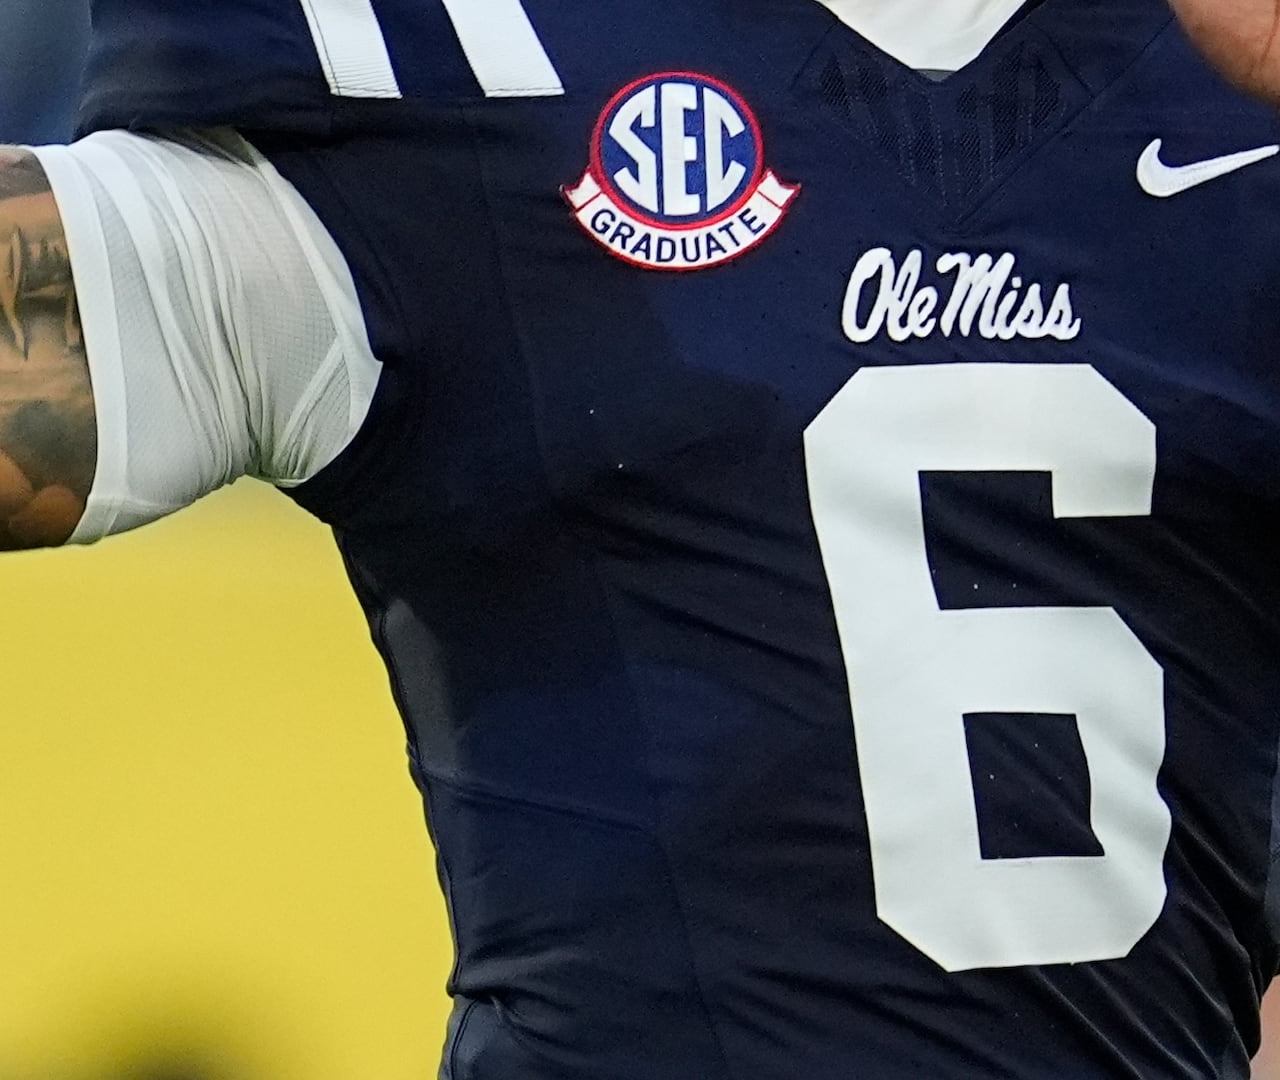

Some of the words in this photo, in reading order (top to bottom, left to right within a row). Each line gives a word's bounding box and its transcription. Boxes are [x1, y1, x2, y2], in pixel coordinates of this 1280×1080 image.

[608, 82, 747, 217] SEC
[590, 207, 767, 264] GRADUATE
[841, 246, 939, 344] Ole
[935, 251, 1082, 341] Miss
[803, 361, 1173, 973] 6
